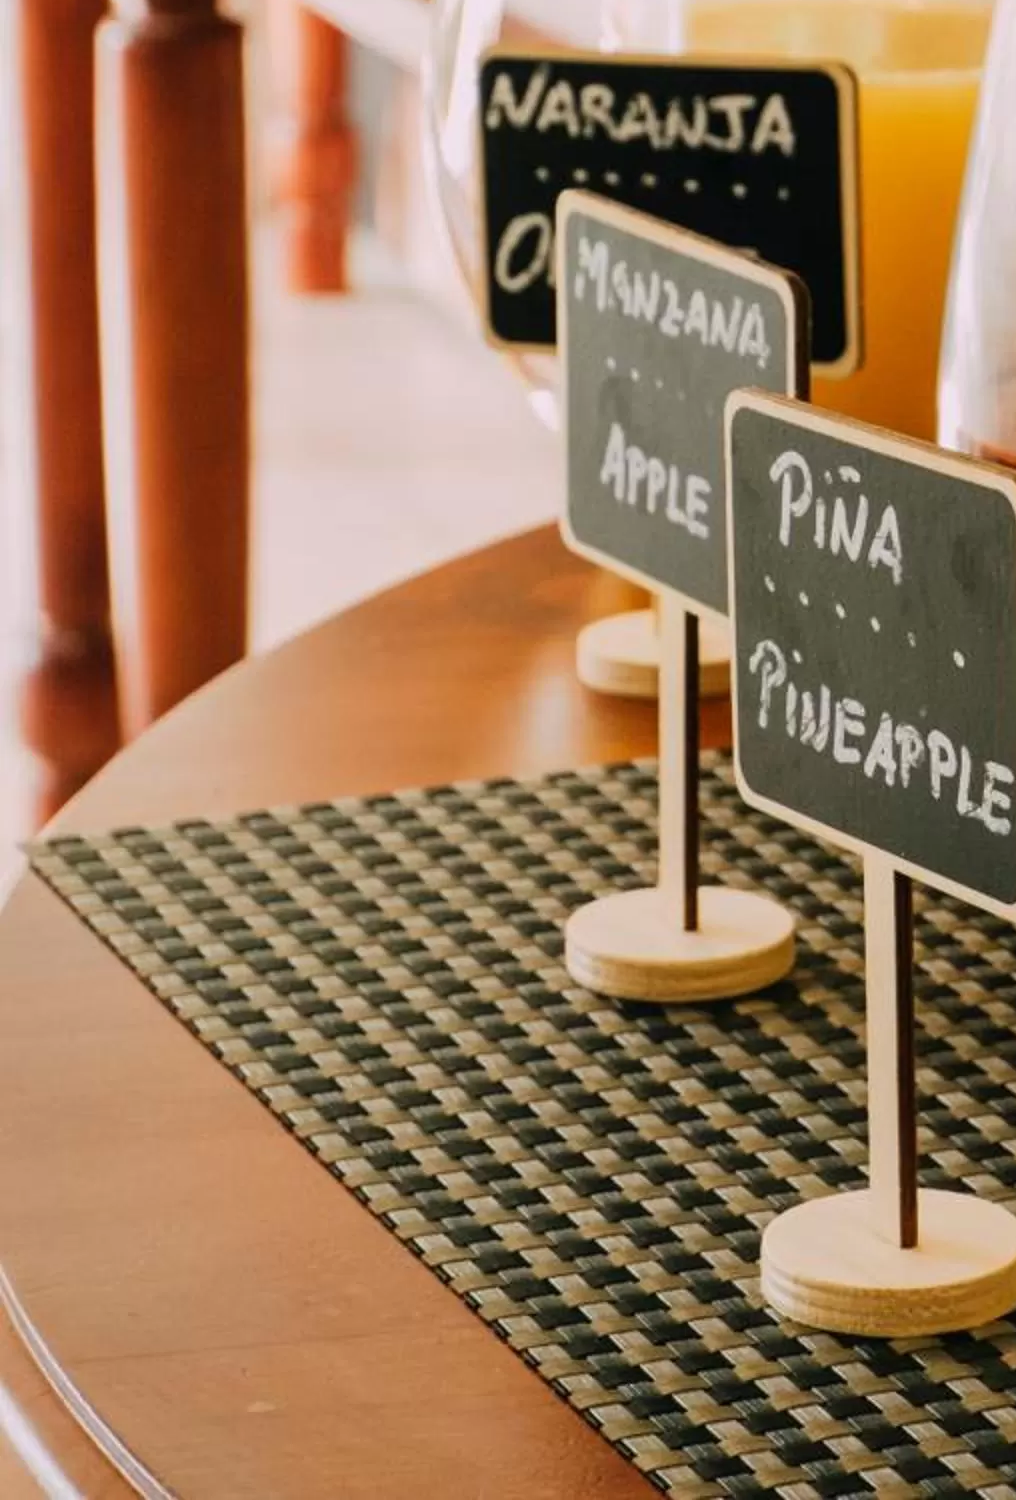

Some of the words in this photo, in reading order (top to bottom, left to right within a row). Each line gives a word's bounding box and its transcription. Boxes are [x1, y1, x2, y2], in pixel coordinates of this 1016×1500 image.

[486, 64, 796, 156] NARANJA
[574, 237, 772, 369] MANZANA
[601, 421, 713, 540] APPLE
